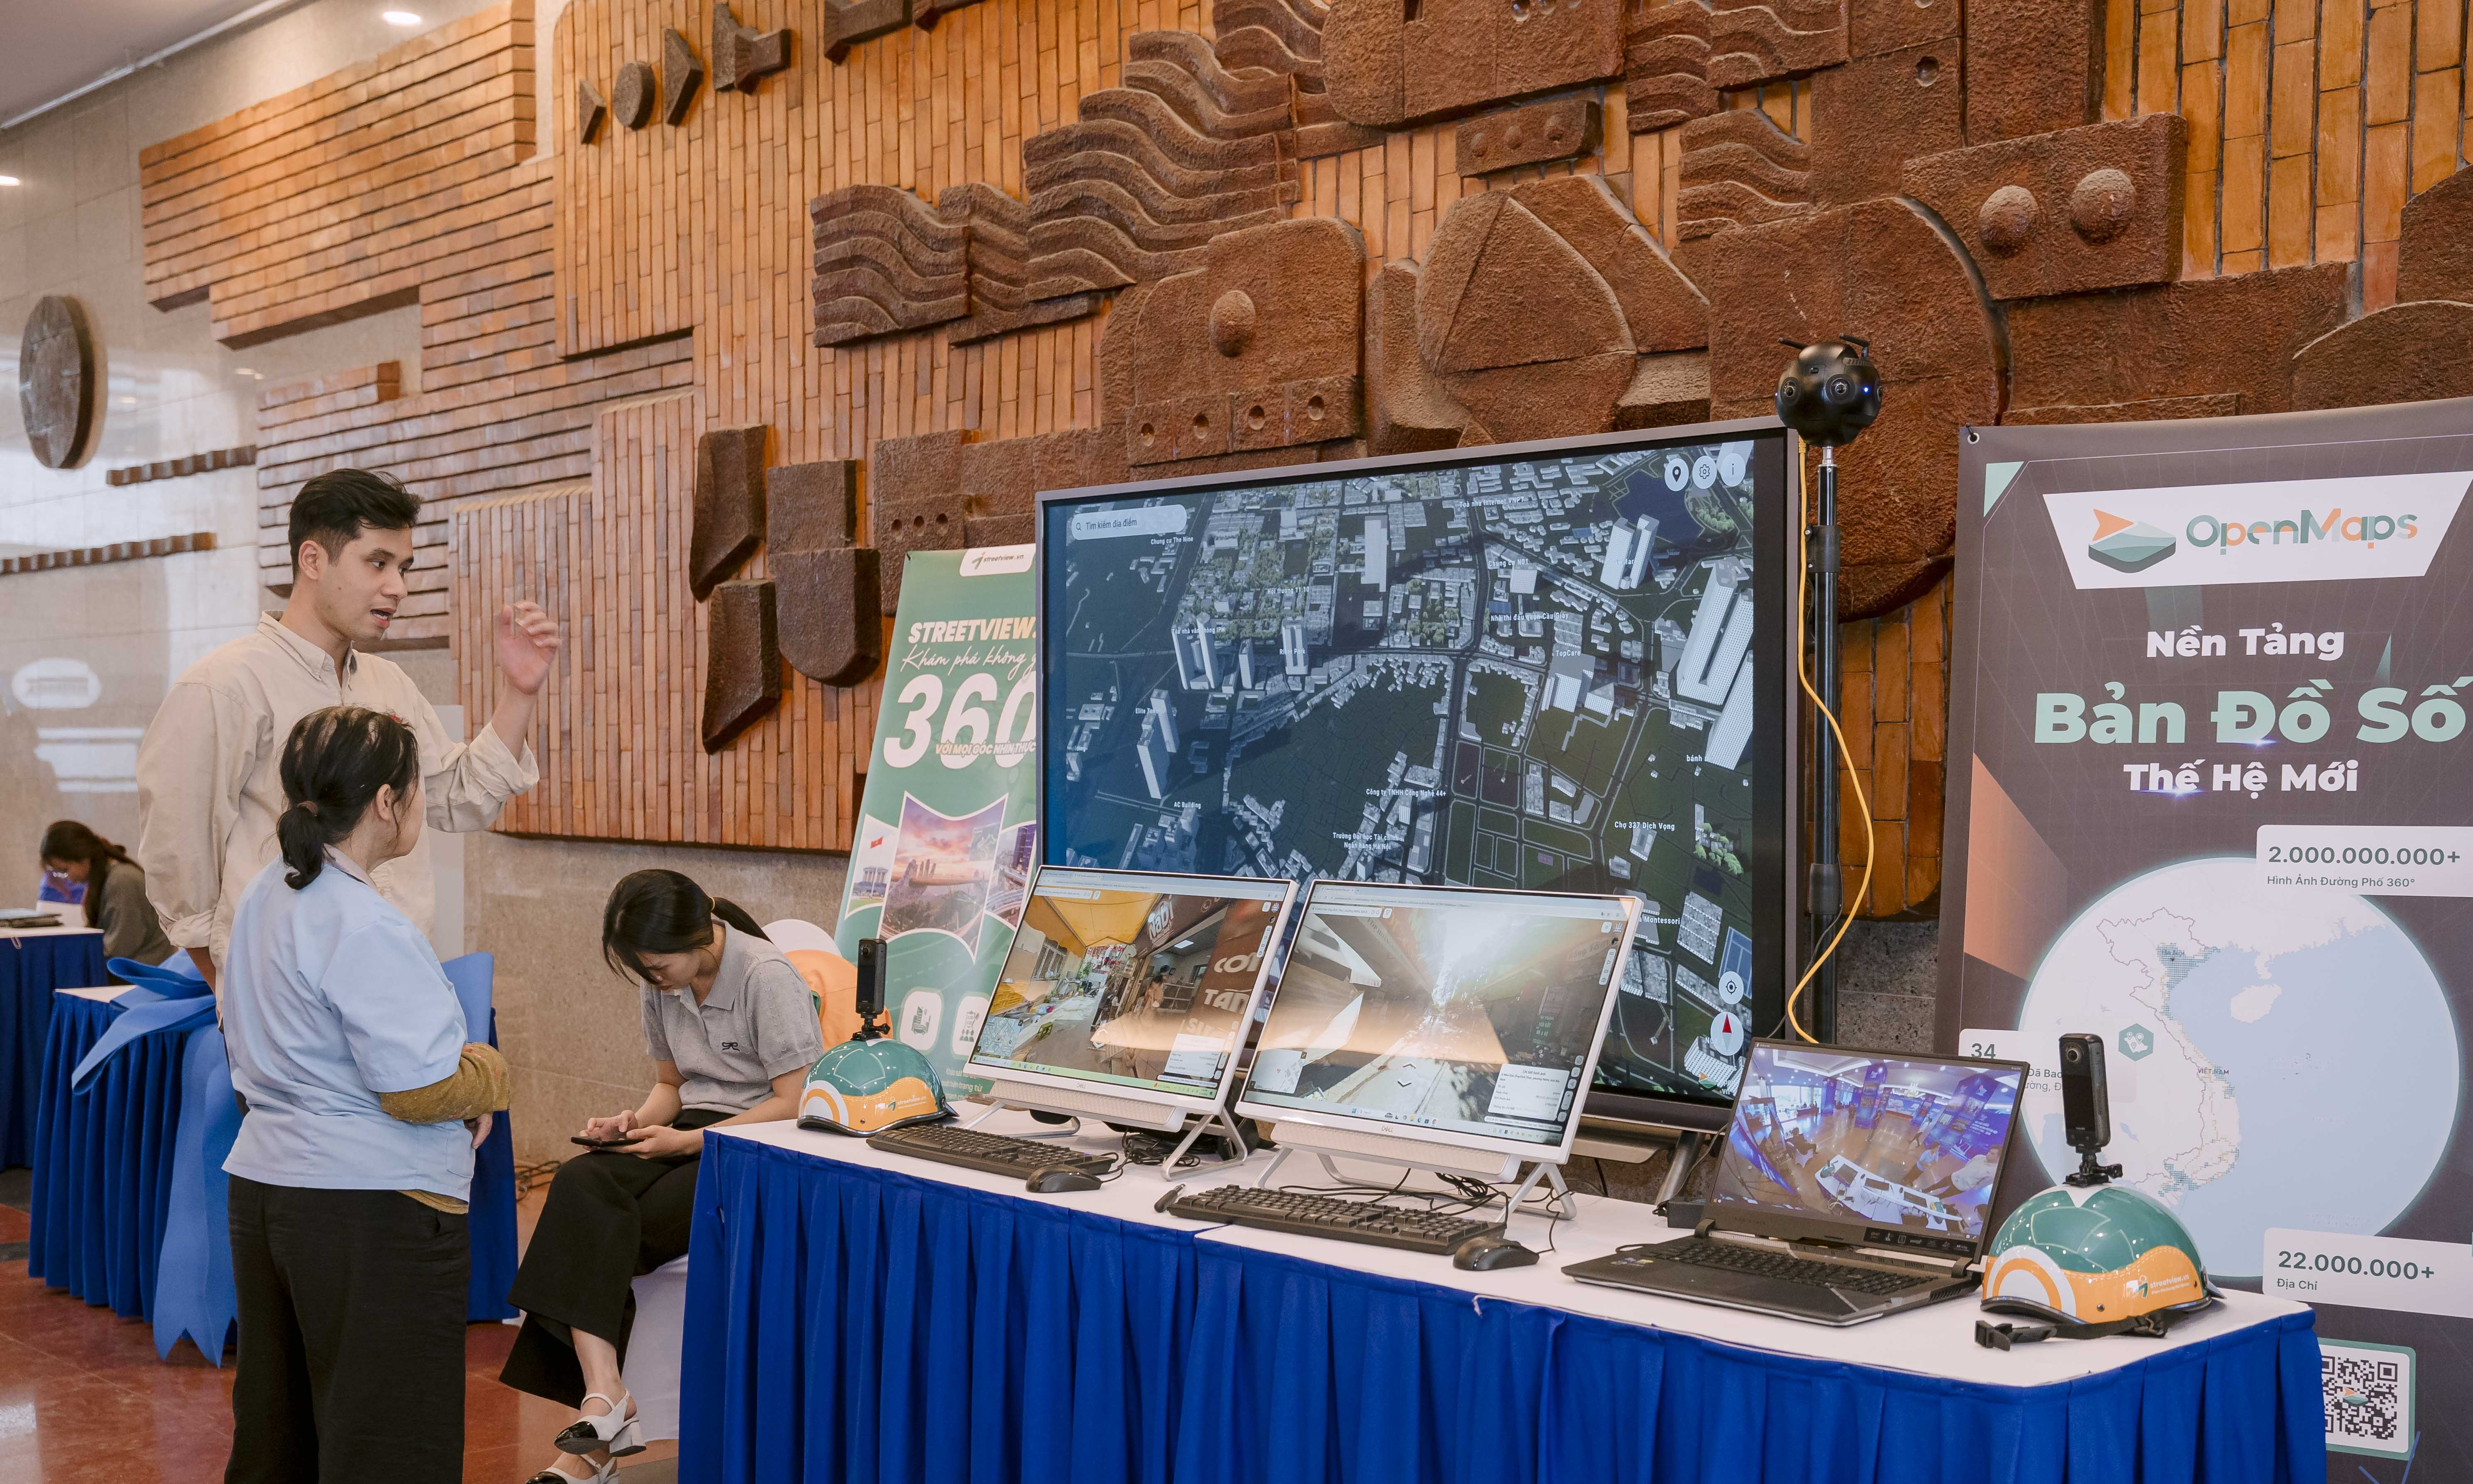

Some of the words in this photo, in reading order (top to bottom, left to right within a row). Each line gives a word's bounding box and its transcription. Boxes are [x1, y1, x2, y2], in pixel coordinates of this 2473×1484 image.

[2186, 508, 2418, 555] OpenMaps
[1488, 560, 1506, 568] Chung
[2146, 625, 2226, 658] Nền
[2239, 622, 2345, 661] Tảng
[1555, 649, 1581, 658] TopCare
[900, 644, 950, 672] Khám
[947, 646, 981, 676] phá
[982, 644, 1027, 681] không
[2034, 682, 2186, 744] Bản
[2210, 679, 2334, 744] Đồ
[2356, 676, 2473, 744] Số
[884, 673, 1036, 769] 360
[935, 740, 953, 754] VỚI
[954, 743, 972, 758] MỌI
[972, 740, 993, 754] GÓC
[2123, 759, 2206, 792] Thế
[2212, 762, 2268, 799] Hệ
[2281, 759, 2358, 792] Mới
[1614, 821, 1626, 830] Chợ
[1332, 832, 1352, 841] Trường
[2268, 846, 2461, 865] 2.000.000.000+
[2267, 876, 2292, 886] Hình
[2295, 874, 2318, 886] Ảnh
[2320, 876, 2359, 888] Đường
[2361, 877, 2384, 887] Phố
[2386, 878, 2415, 888] 360°
[1644, 916, 1680, 925] Montessori
[1971, 1042, 1996, 1059] 34
[2025, 1081, 2051, 1092] ường,
[2053, 1082, 2062, 1091] Đ
[2278, 1250, 2434, 1280] 22.000.000+
[2276, 1278, 2295, 1290] Địa
[2298, 1280, 2318, 1291] Chỉ
